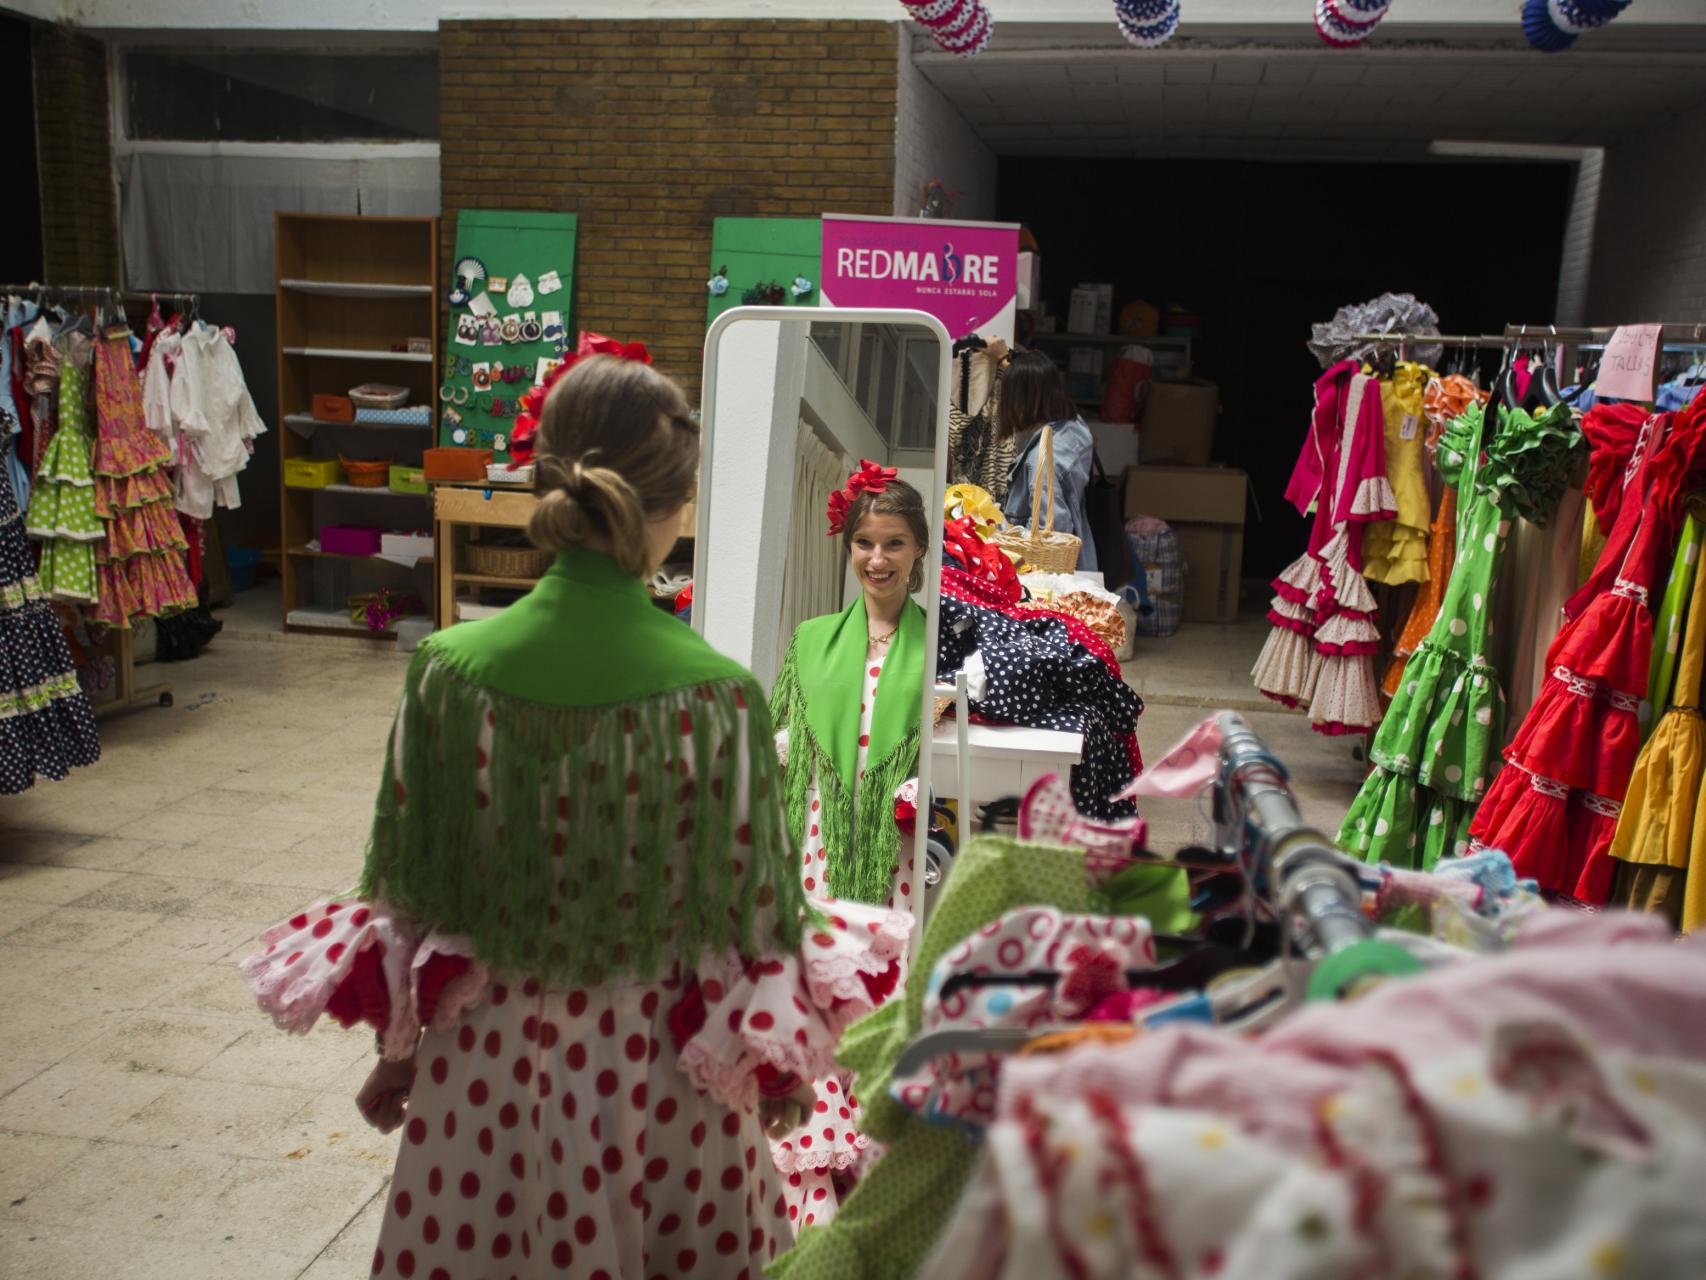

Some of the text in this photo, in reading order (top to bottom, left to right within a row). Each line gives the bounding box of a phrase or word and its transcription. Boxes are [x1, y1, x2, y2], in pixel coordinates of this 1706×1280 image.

[837, 244, 999, 284] REDMADRE
[916, 286, 942, 294] NUNCA
[978, 289, 998, 297] SOLA
